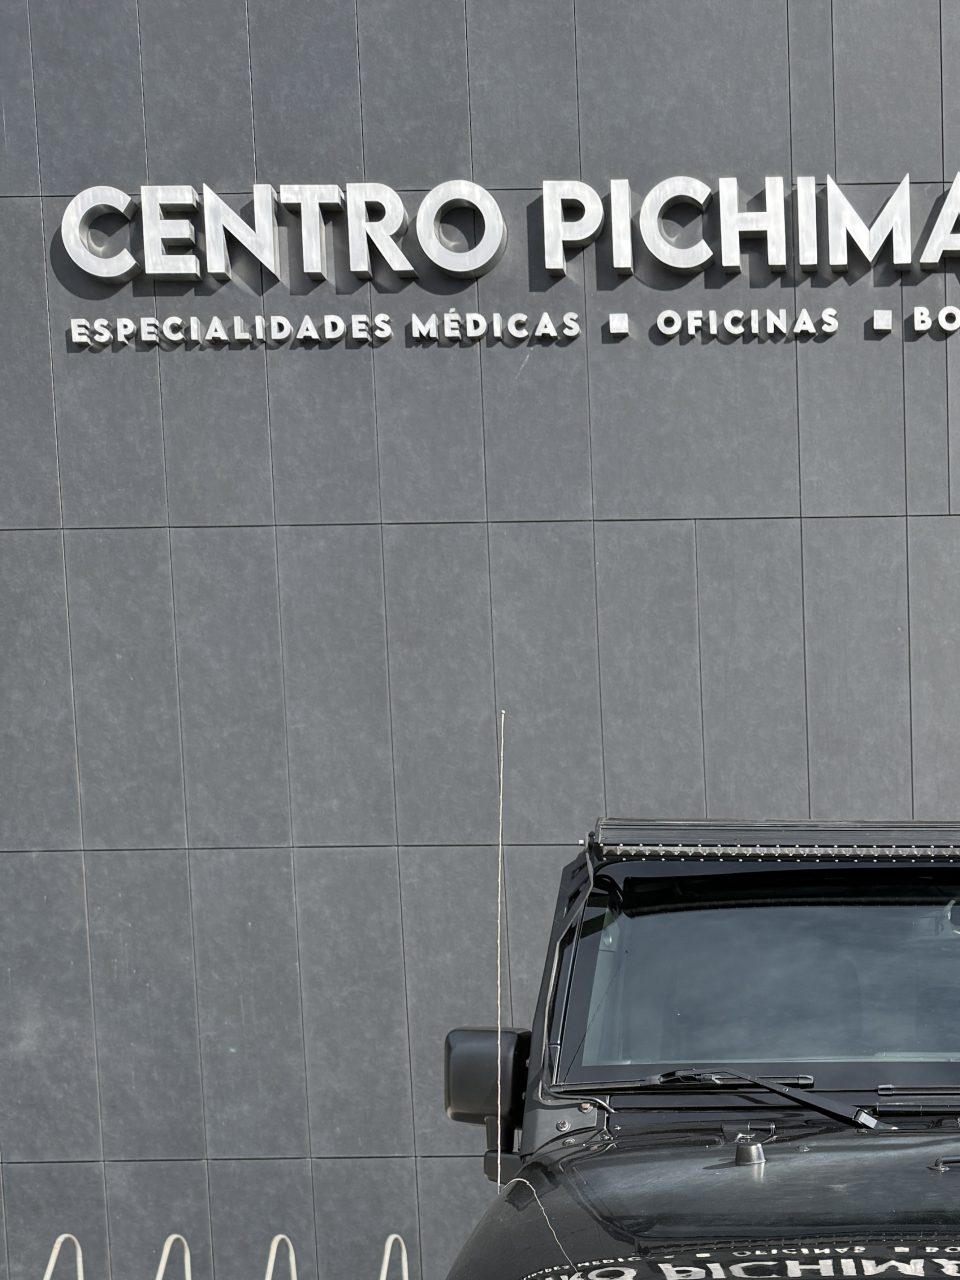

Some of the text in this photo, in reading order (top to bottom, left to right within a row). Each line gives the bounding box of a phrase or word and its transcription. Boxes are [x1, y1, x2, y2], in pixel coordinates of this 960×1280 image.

[60, 179, 504, 280] CENTRO
[70, 311, 393, 345] ESPECIALIDADES
[411, 308, 581, 339] MÉDICAS
[656, 307, 839, 336] OFICINAS
